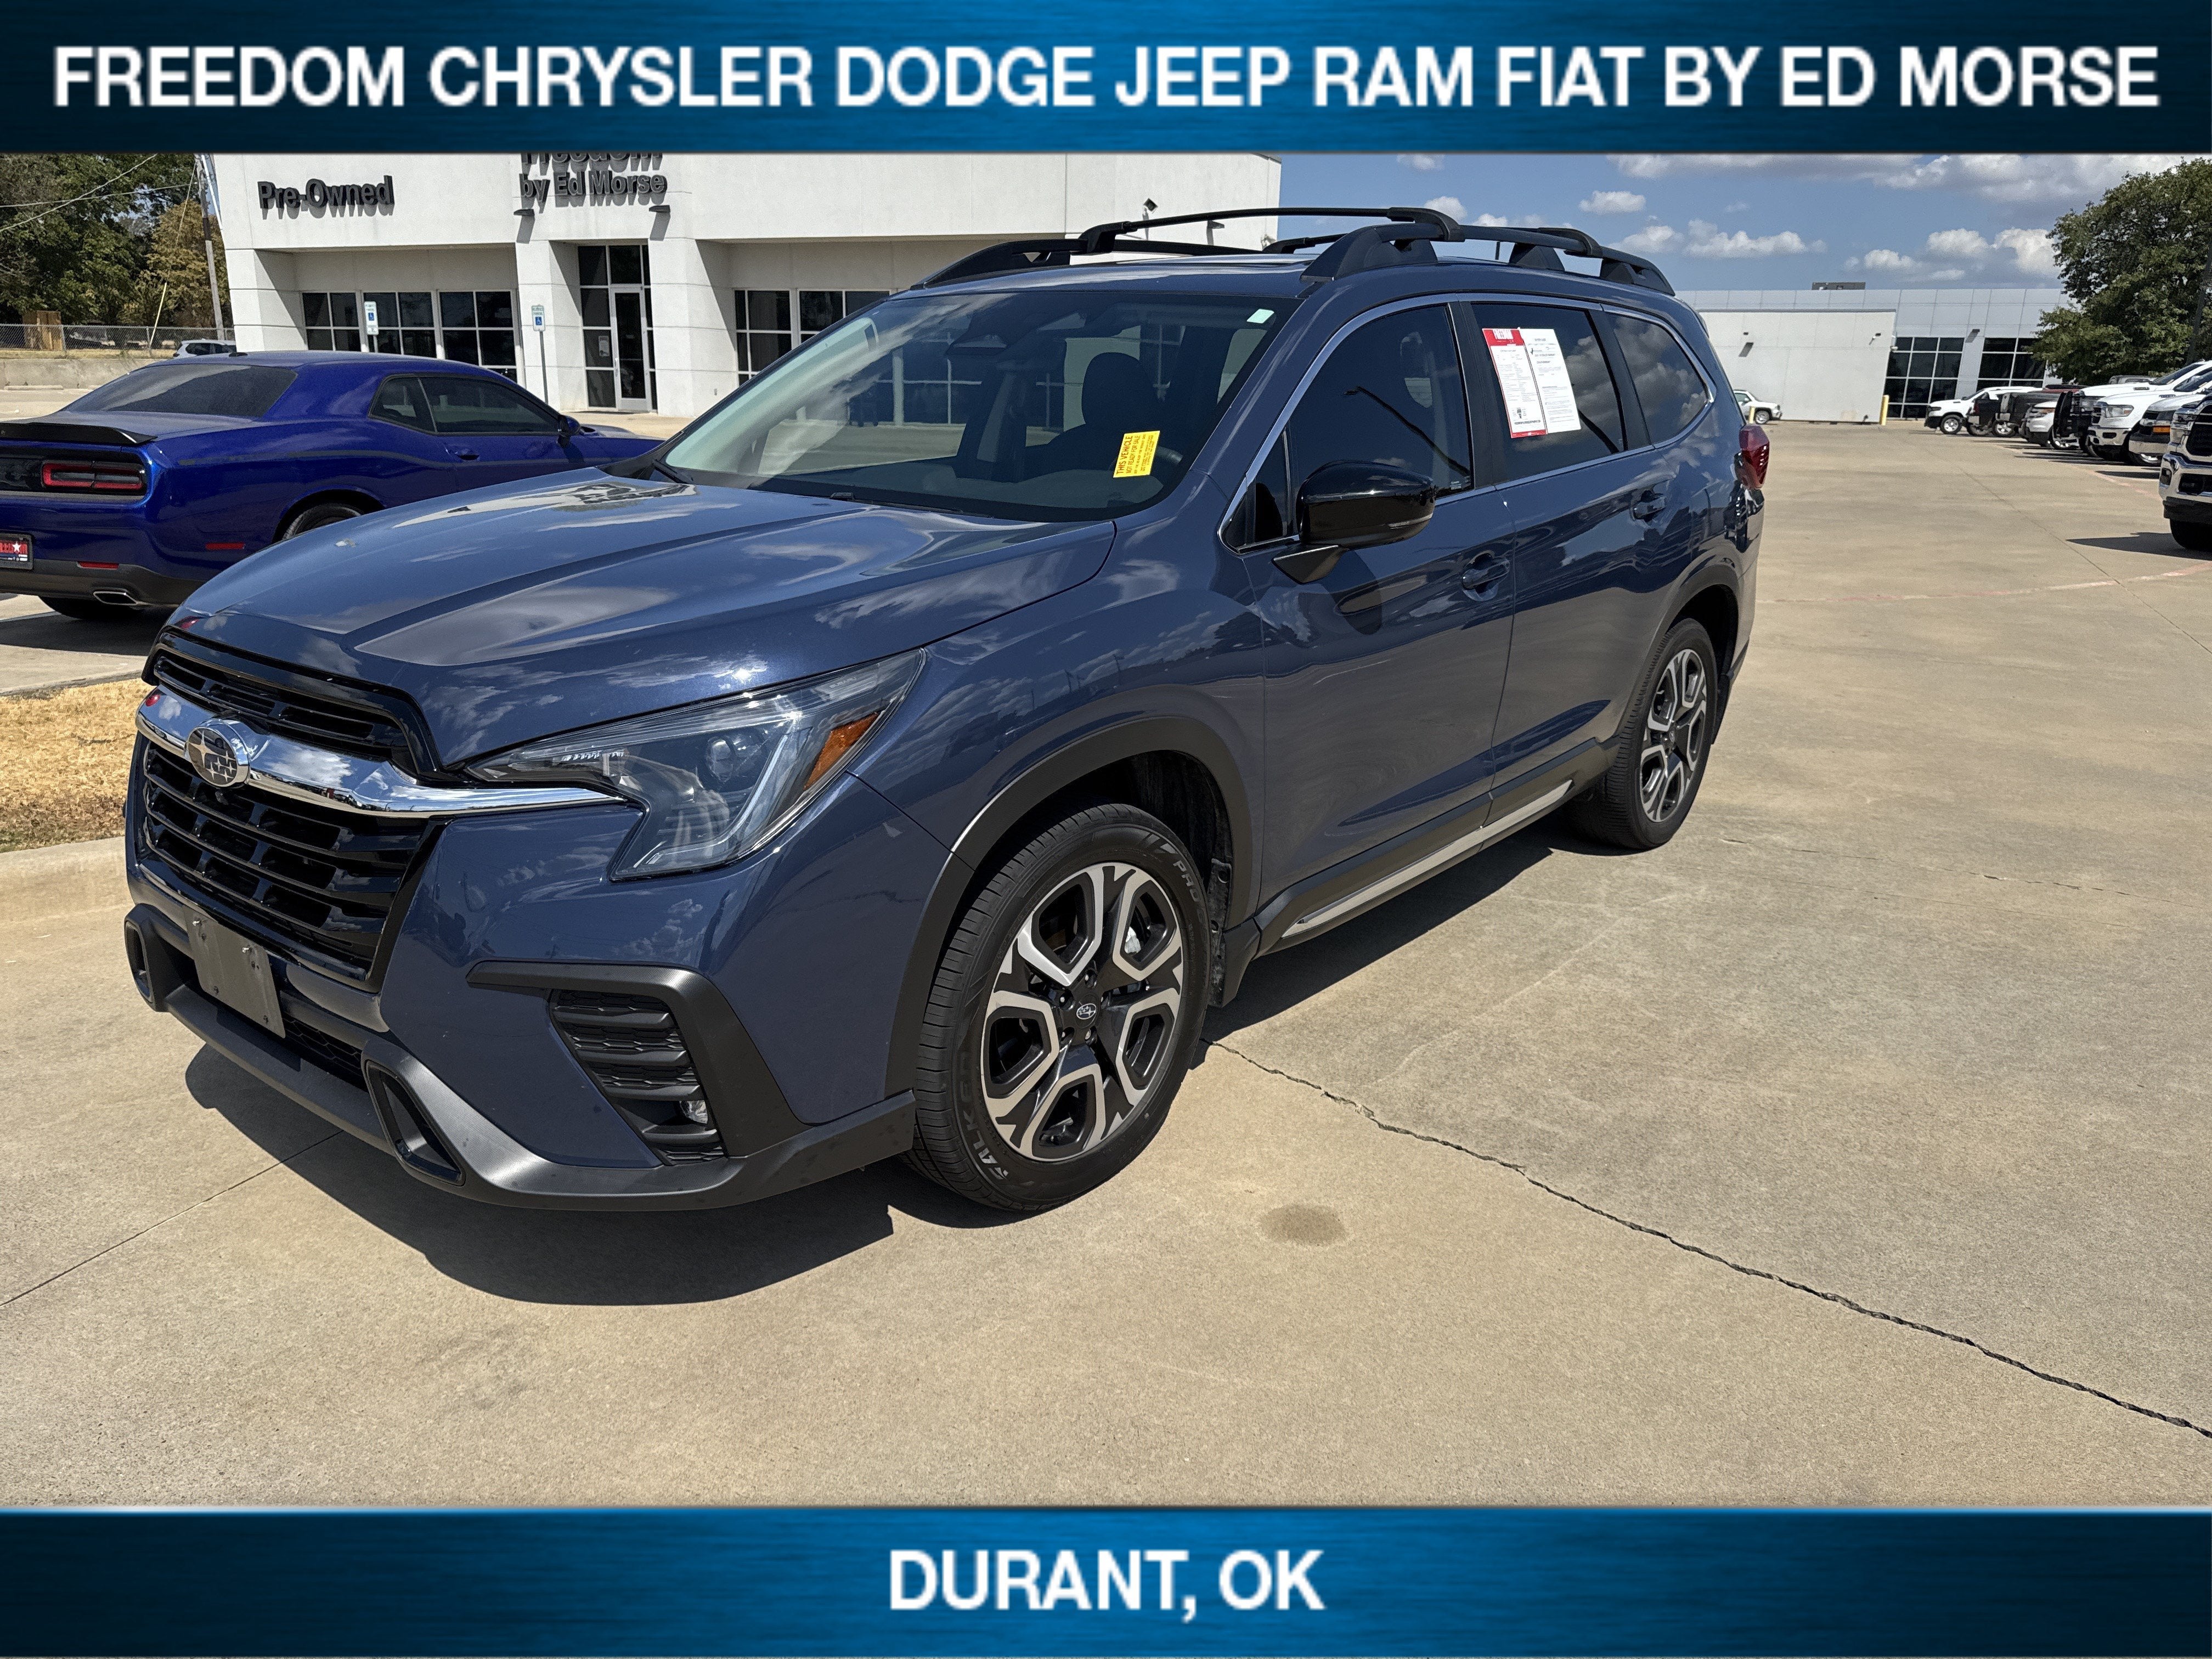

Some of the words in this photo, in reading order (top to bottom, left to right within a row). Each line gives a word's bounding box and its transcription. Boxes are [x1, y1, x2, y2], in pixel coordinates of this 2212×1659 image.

[257, 175, 394, 210] Pre-Owned
[519, 173, 550, 203] by
[554, 171, 585, 196] Ed
[589, 170, 668, 195] Morse
[1120, 436, 1133, 460] VEHICLE
[1116, 461, 1126, 475] THIS
